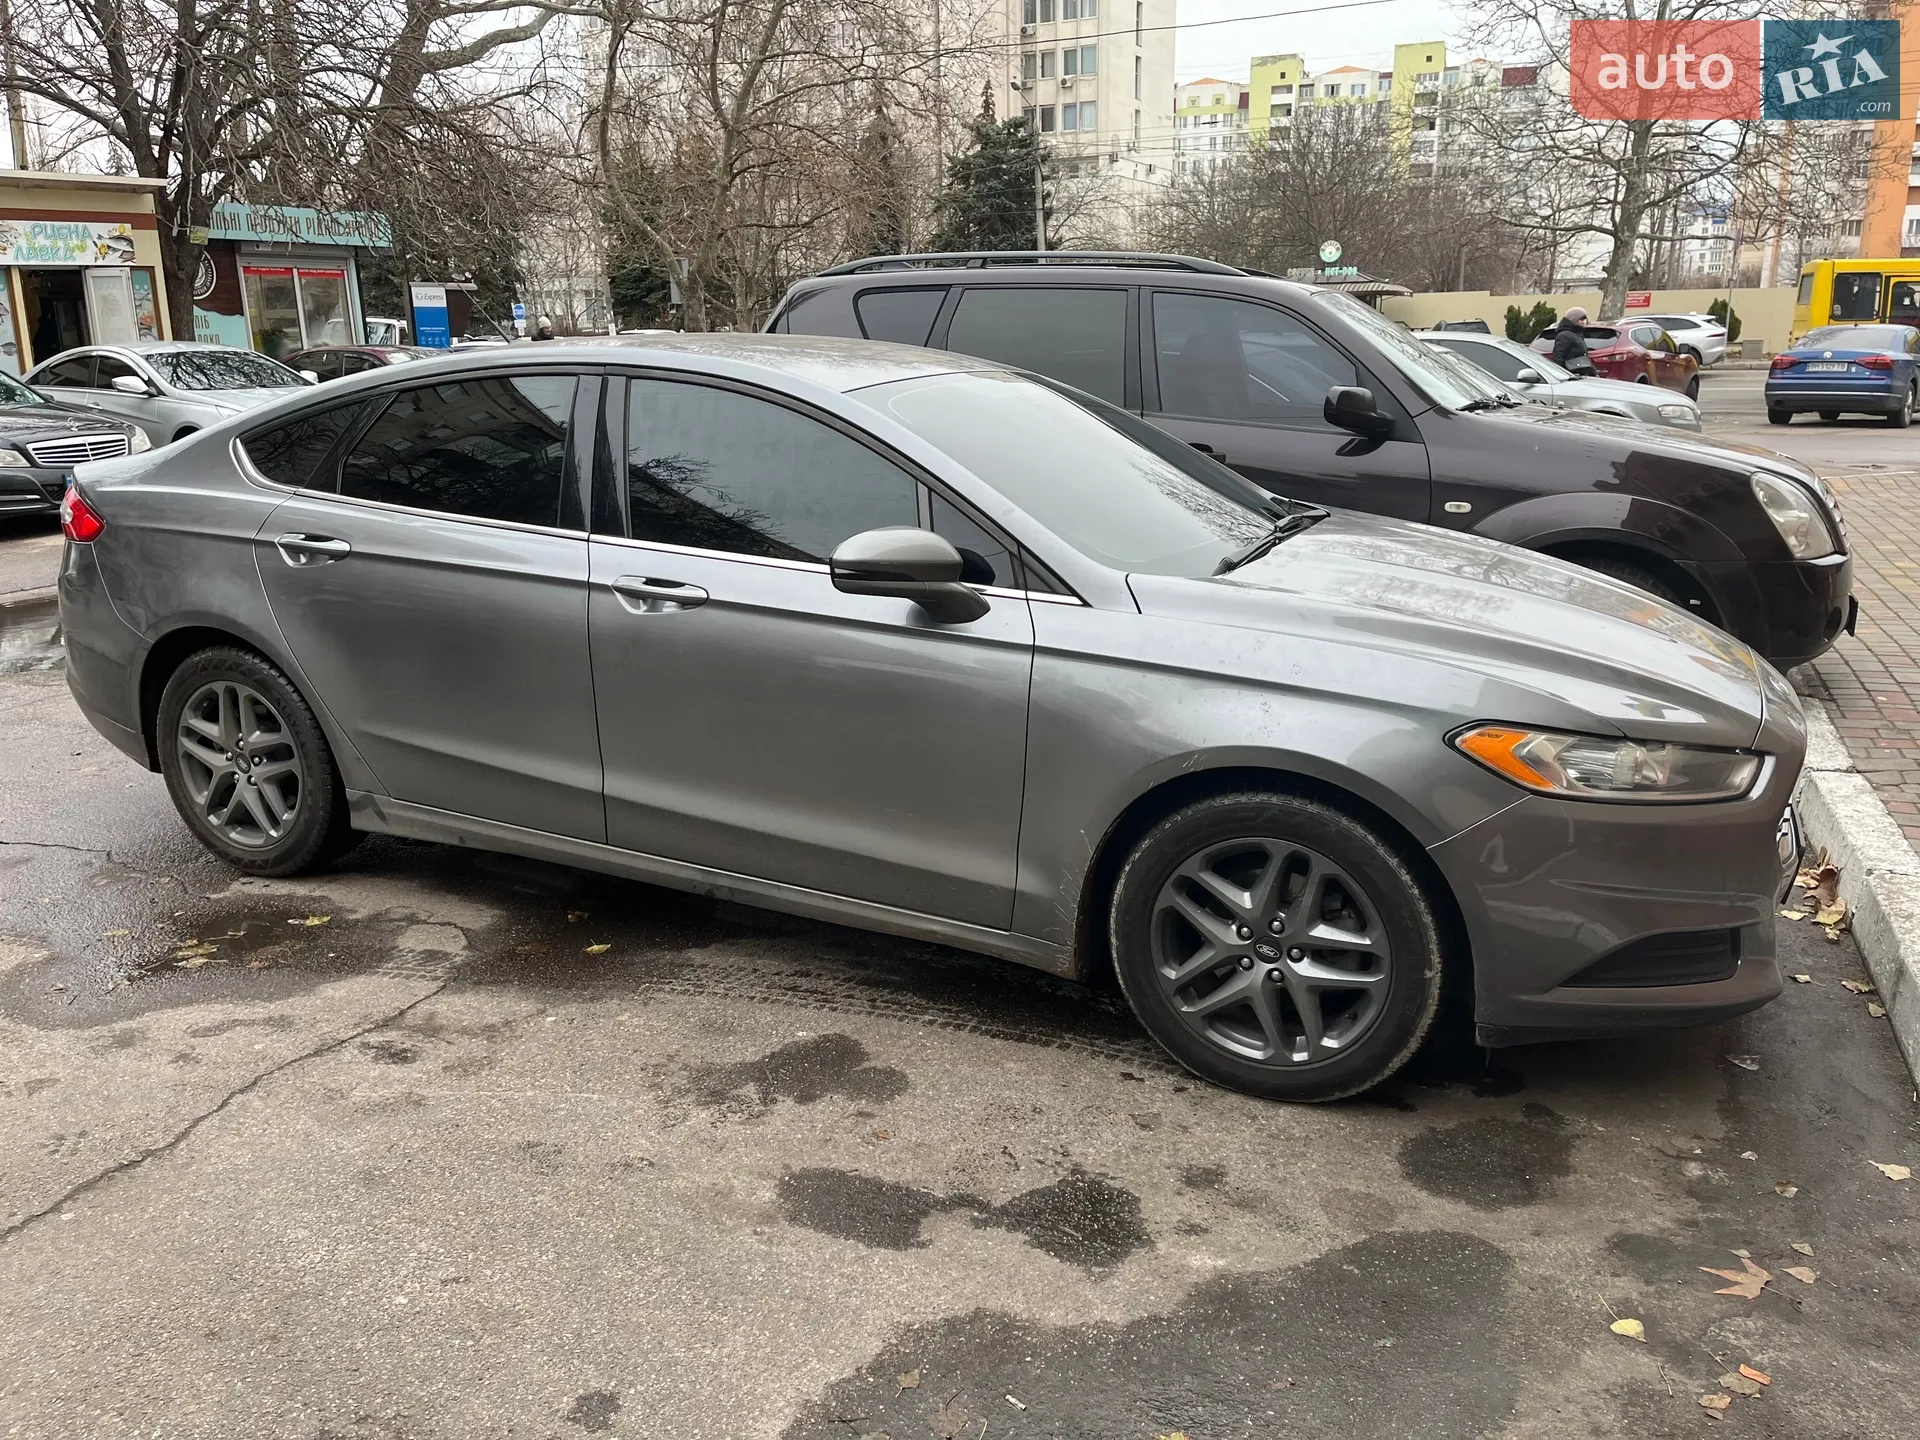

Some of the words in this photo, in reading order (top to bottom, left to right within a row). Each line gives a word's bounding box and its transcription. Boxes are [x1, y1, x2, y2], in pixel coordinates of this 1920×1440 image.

[30, 222, 93, 240] РИБНА
[245, 213, 301, 235] ПРОДУКТИ
[13, 244, 76, 262] ЛАВКА
[1324, 266, 1358, 276] HOT-DOG
[424, 292, 444, 302] Express
